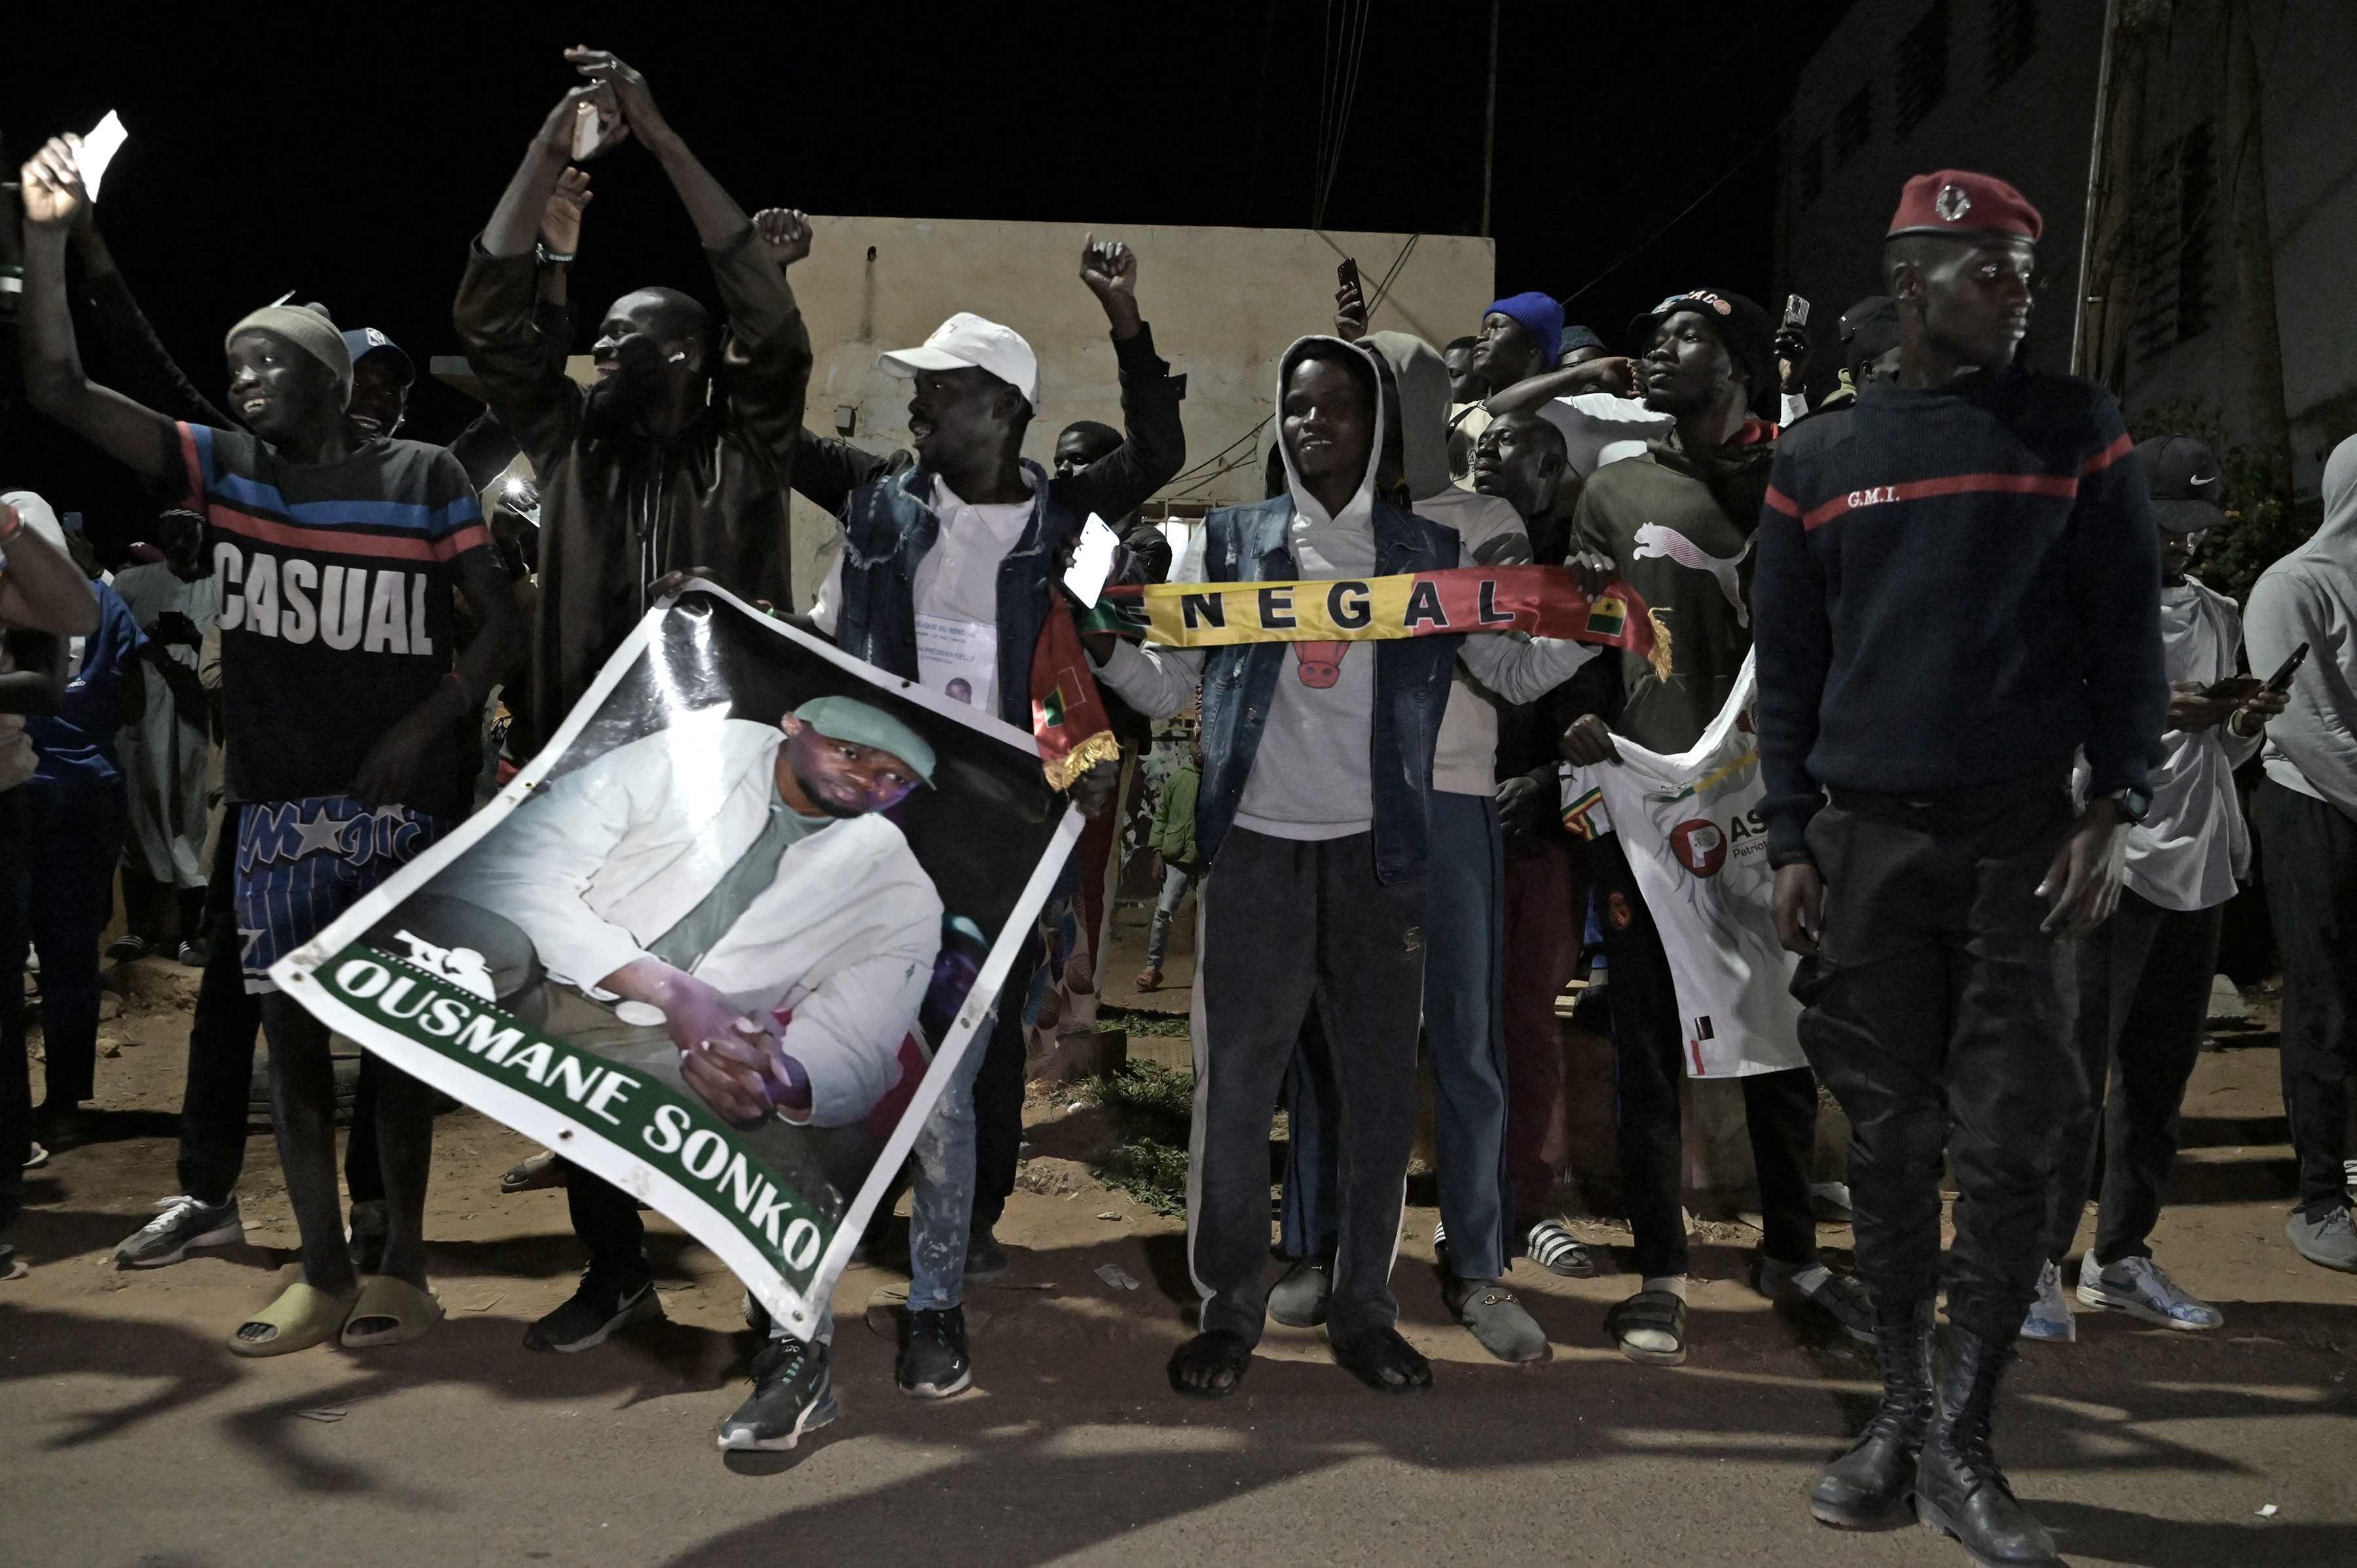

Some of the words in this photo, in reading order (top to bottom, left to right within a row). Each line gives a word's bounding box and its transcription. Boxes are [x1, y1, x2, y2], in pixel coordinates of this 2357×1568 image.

[1848, 486, 1901, 508] G.M.I.
[213, 541, 433, 655] CASUAL
[335, 960, 641, 1125] OUSMANE
[642, 1104, 820, 1271] SONKO
